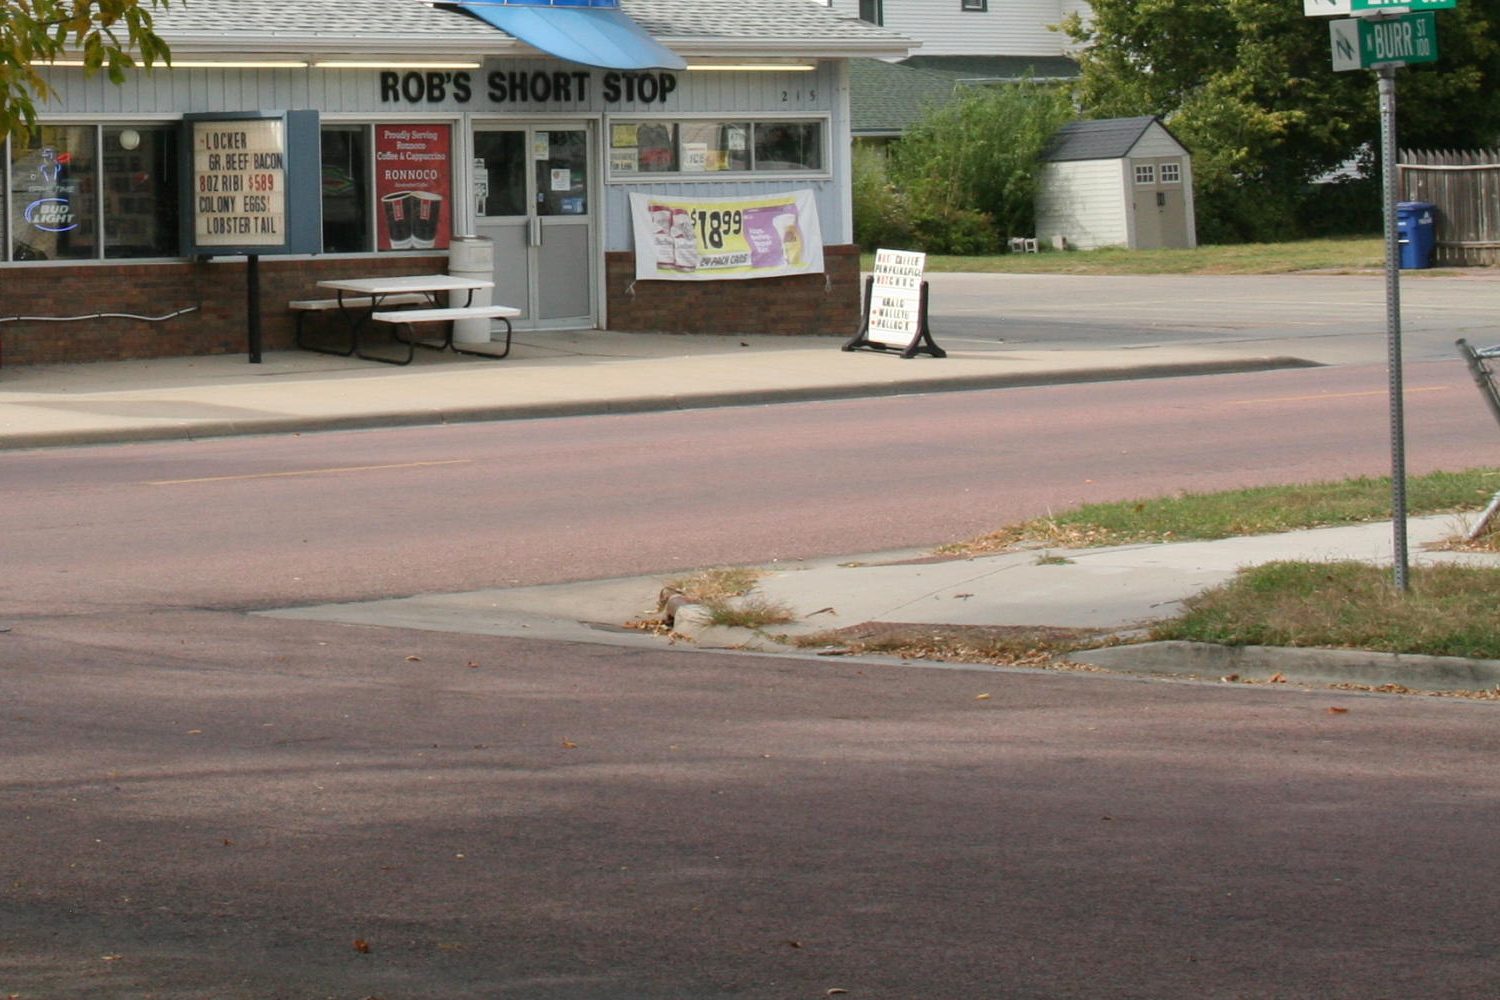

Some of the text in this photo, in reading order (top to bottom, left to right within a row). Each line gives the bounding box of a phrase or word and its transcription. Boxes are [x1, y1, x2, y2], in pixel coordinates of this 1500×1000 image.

[1374, 22, 1414, 59] BURR
[1416, 19, 1426, 36] ST
[1415, 37, 1430, 57] 100
[380, 71, 677, 103] ROB'S SHORT STOP
[384, 130, 438, 141] Proudly Serving
[254, 153, 283, 169] BACON
[377, 151, 398, 160] Coffee
[248, 174, 274, 191] $589
[385, 169, 438, 180] RONNOCO
[40, 204, 69, 214] BUD
[199, 196, 235, 213] COLONY
[32, 214, 75, 223] LIGHT
[207, 217, 276, 234] LOBSTER TAIL
